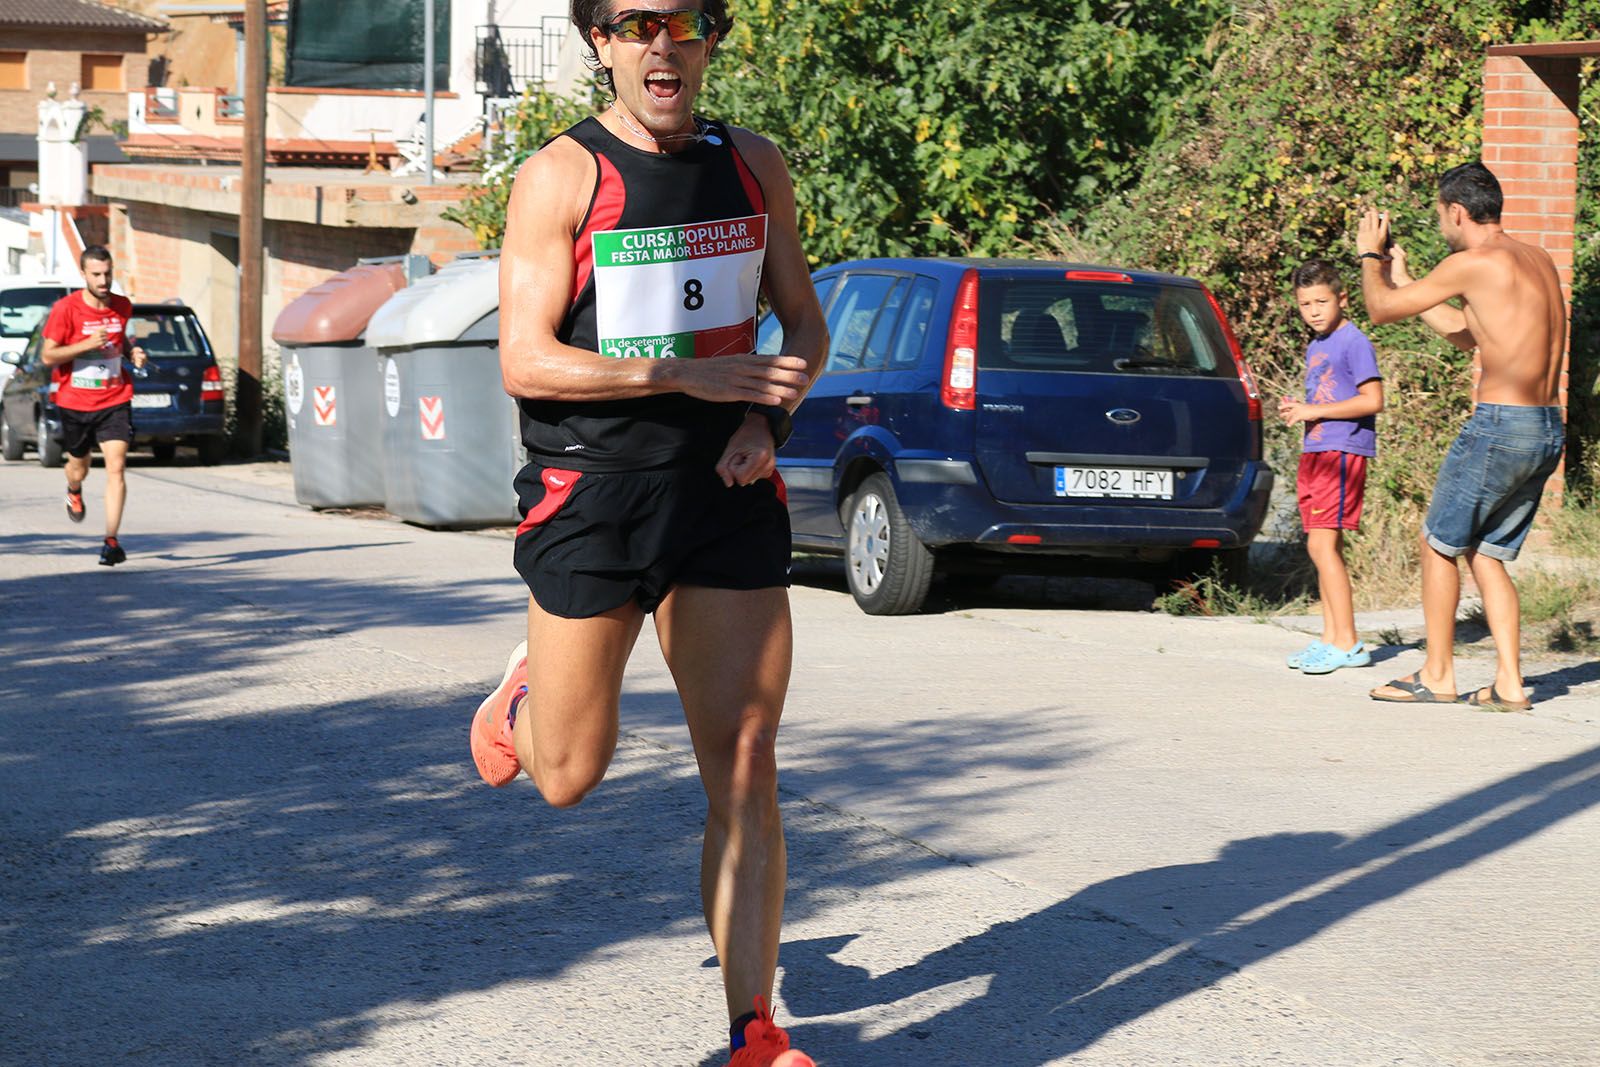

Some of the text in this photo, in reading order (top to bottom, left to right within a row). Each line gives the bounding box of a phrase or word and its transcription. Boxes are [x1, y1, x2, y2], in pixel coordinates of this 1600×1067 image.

[611, 236, 756, 263] FESTA MAJOR LES PLANES
[621, 222, 748, 250] CURSA POPULAR
[683, 279, 705, 311] 8
[605, 336, 677, 348] 11 de setembre
[1072, 469, 1167, 492] 7082 HFY
